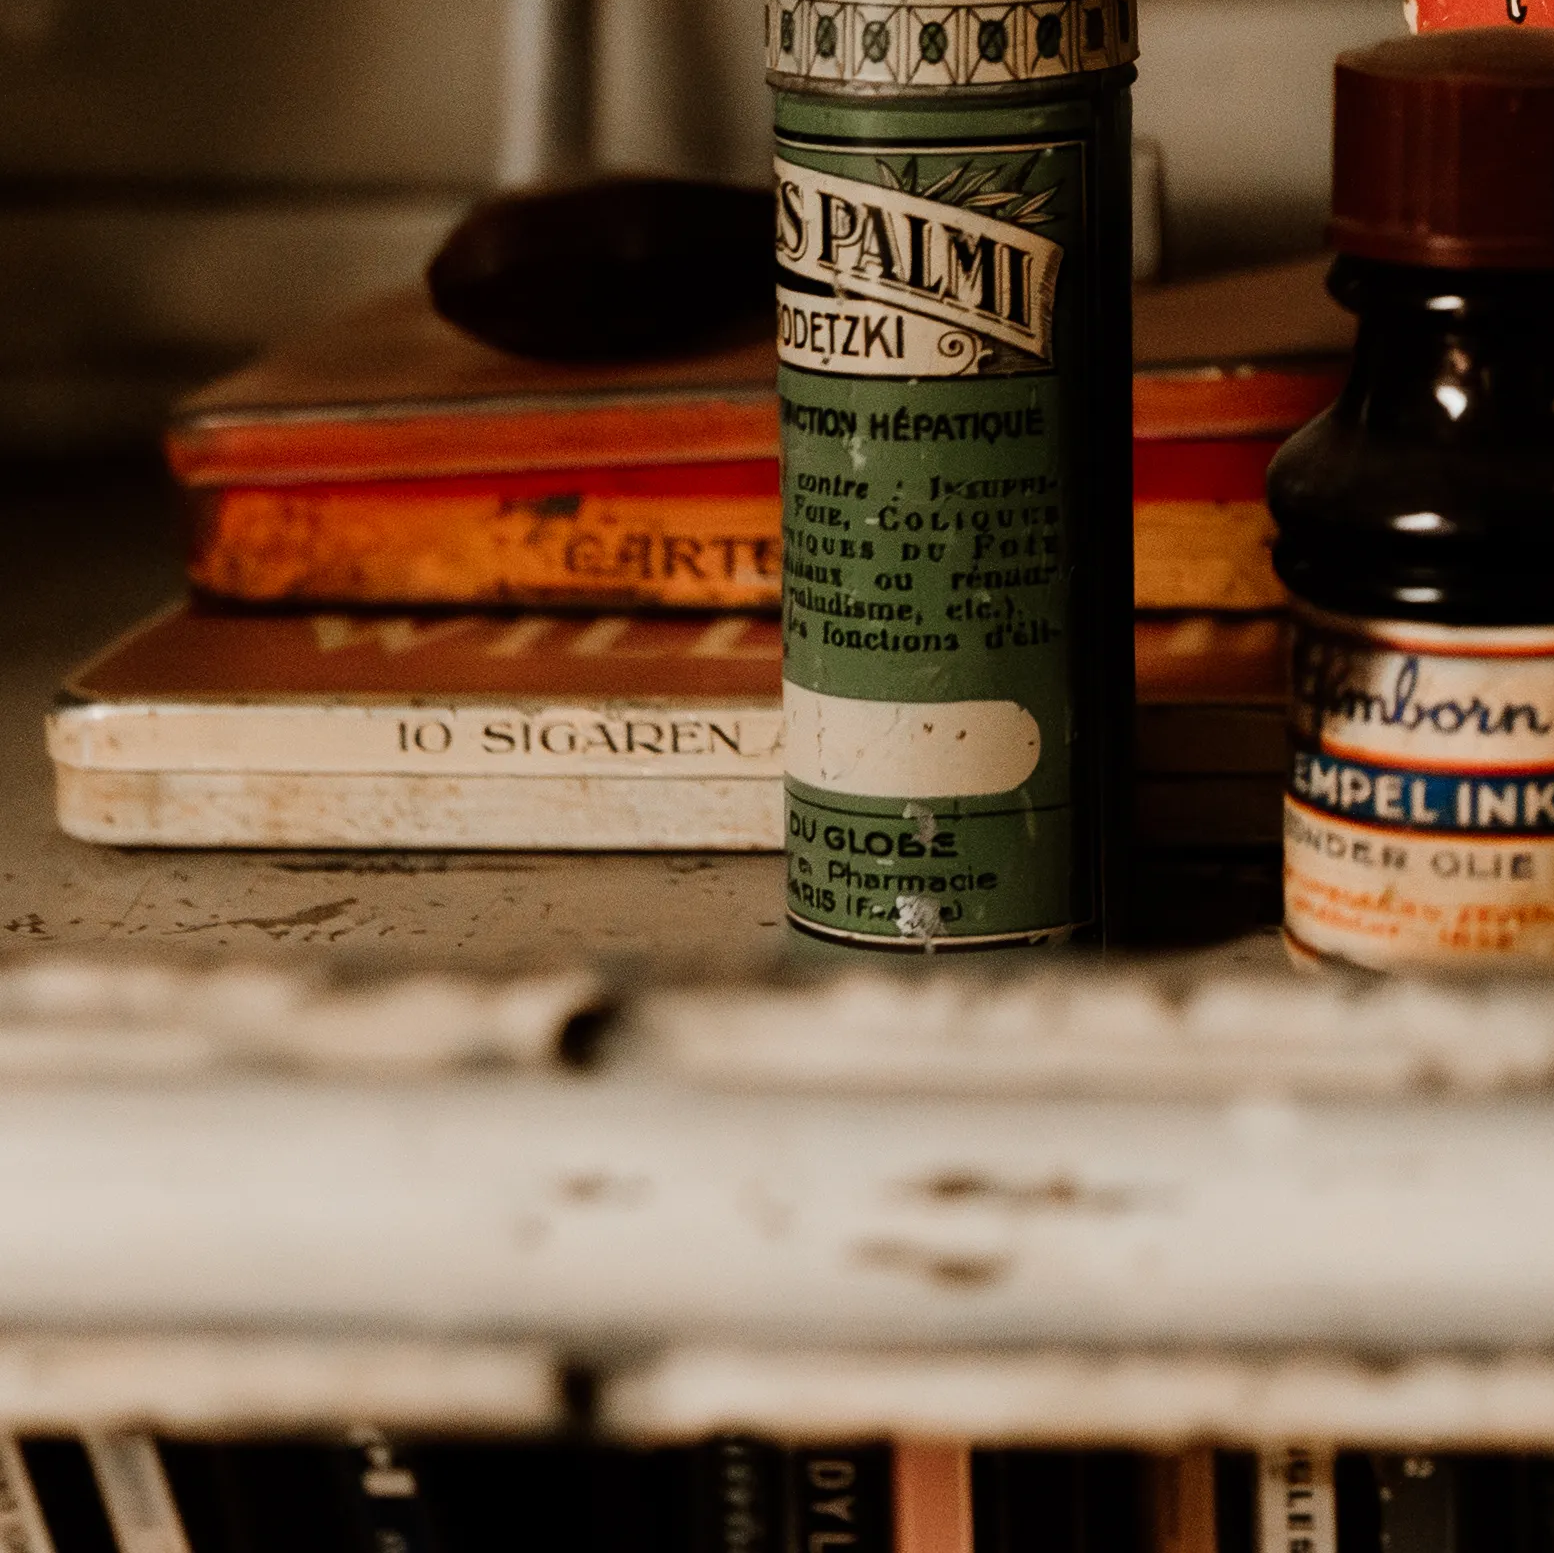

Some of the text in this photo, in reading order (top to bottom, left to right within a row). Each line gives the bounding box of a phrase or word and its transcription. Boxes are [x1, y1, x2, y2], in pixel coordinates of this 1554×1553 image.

[817, 190, 1034, 329] PALMI
[871, 405, 1045, 444] HÉPATIQUE
[797, 473, 869, 500] contre
[875, 571, 913, 591] ou
[481, 719, 743, 757] SIGAREN
[824, 825, 959, 859] GLOBE
[828, 859, 1000, 893] Pharmacie
